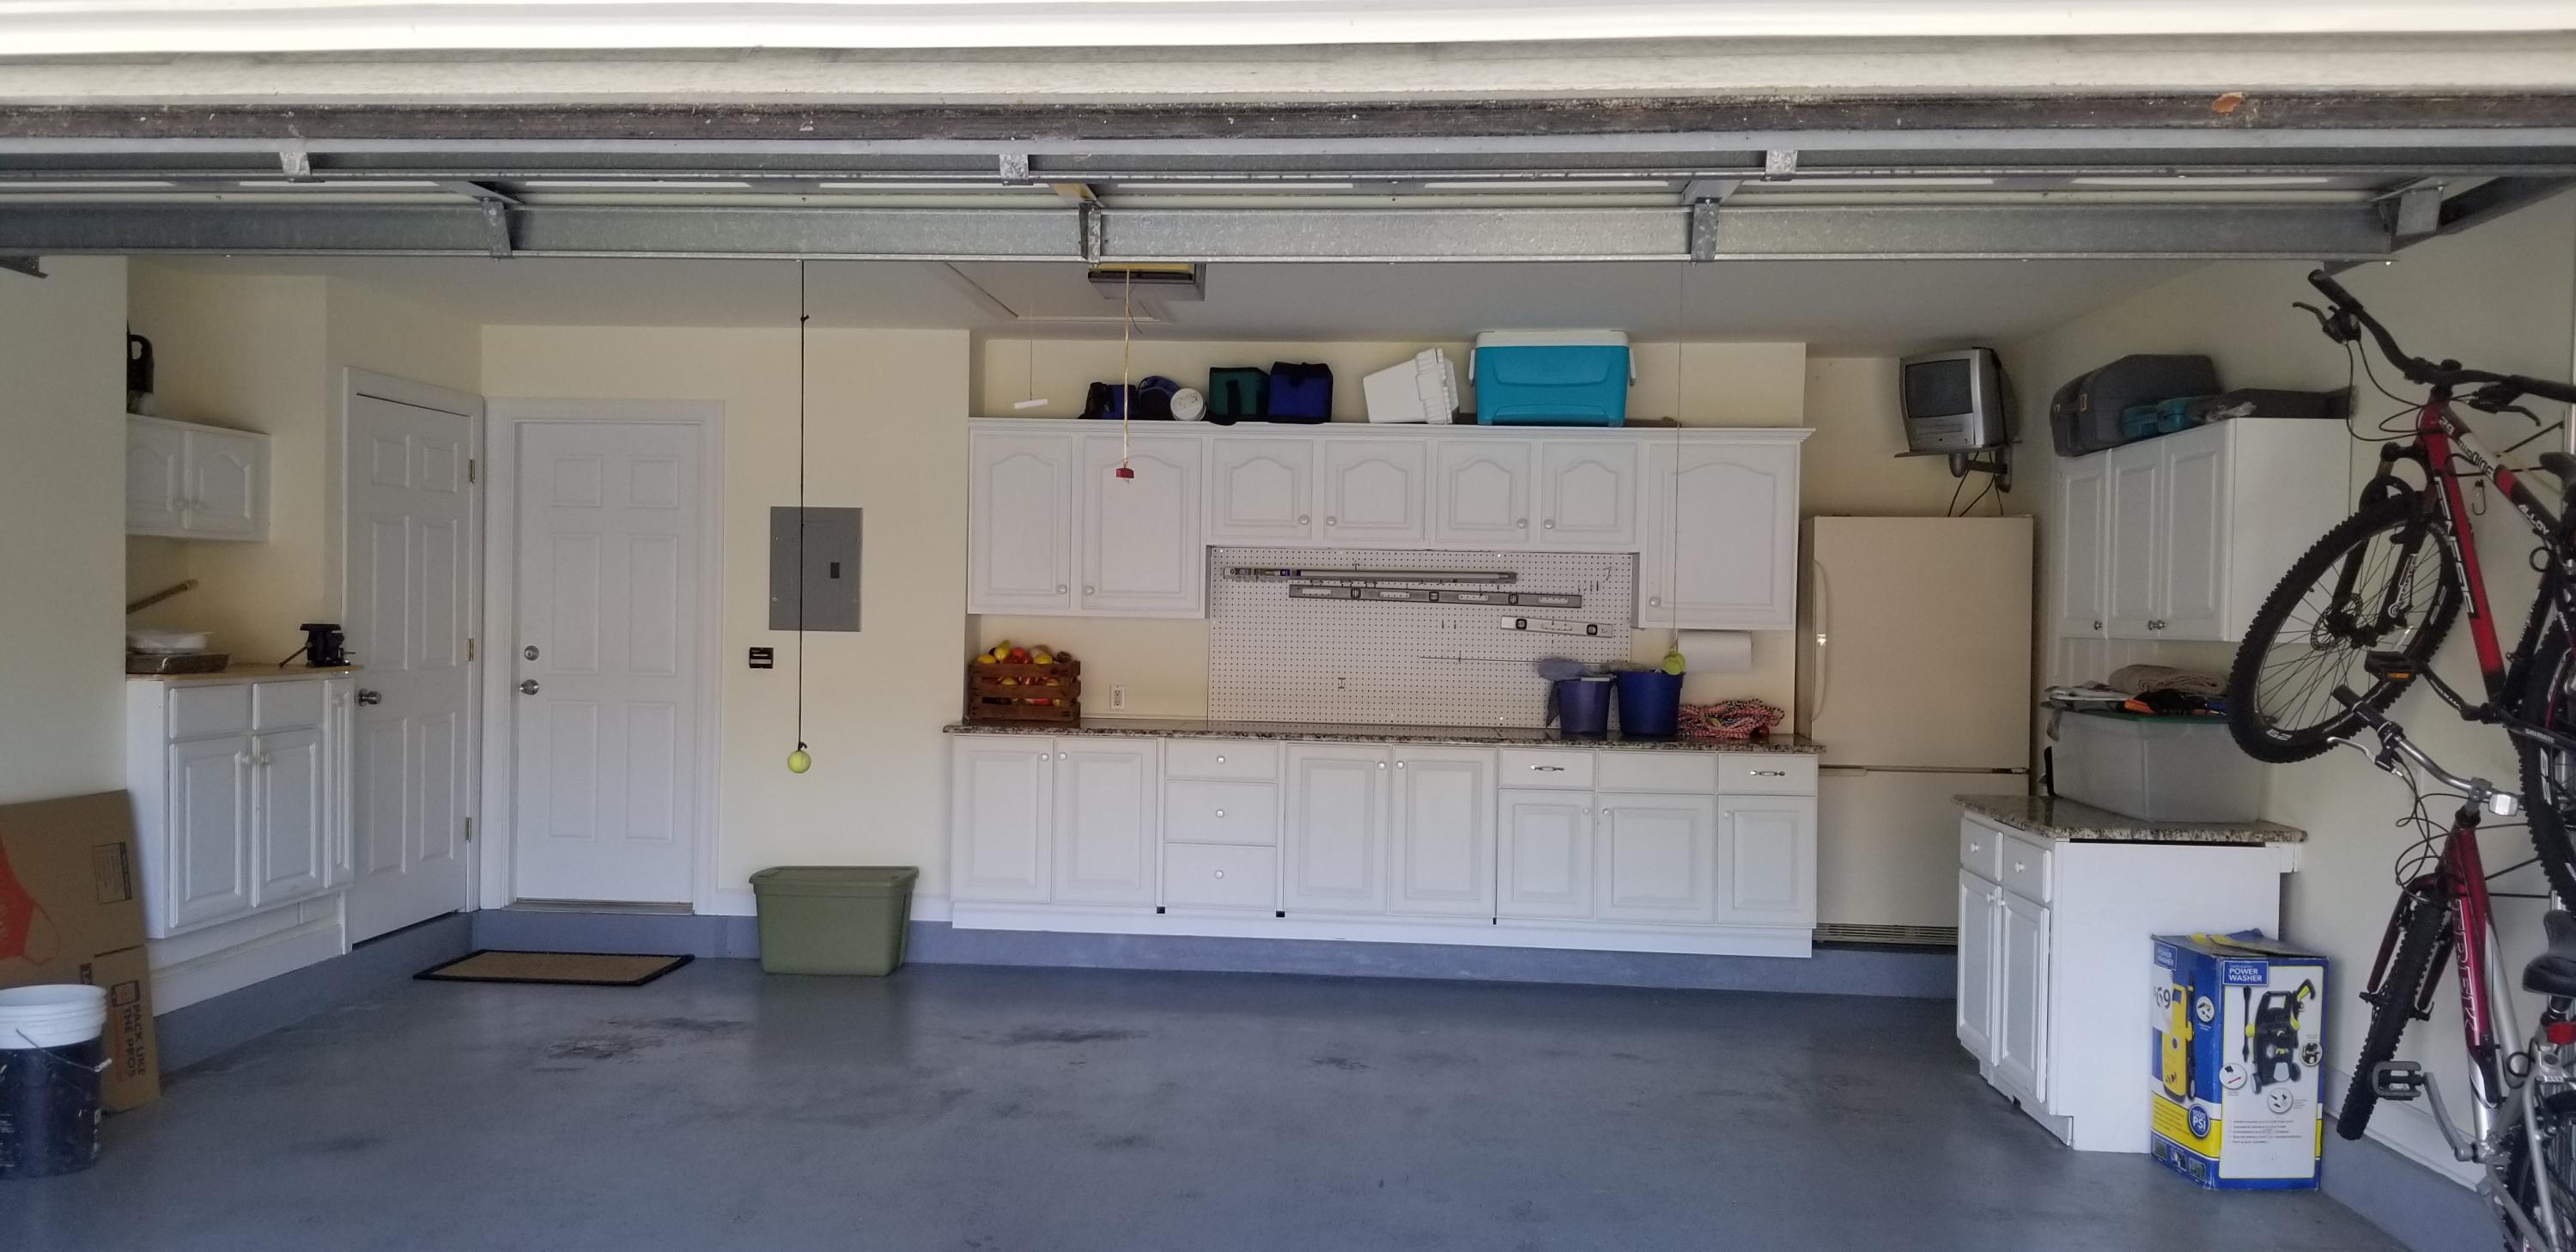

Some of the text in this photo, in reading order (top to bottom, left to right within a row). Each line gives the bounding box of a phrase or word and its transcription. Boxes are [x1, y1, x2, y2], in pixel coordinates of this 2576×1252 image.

[2438, 416, 2455, 435] 29
[2518, 503, 2550, 535] ALLOY
[2451, 898, 2479, 1032] TREK
[124, 1006, 137, 1078] THE PROS
[134, 1004, 146, 1076] PACK LIKE
[2192, 1116, 2207, 1131] PSI
